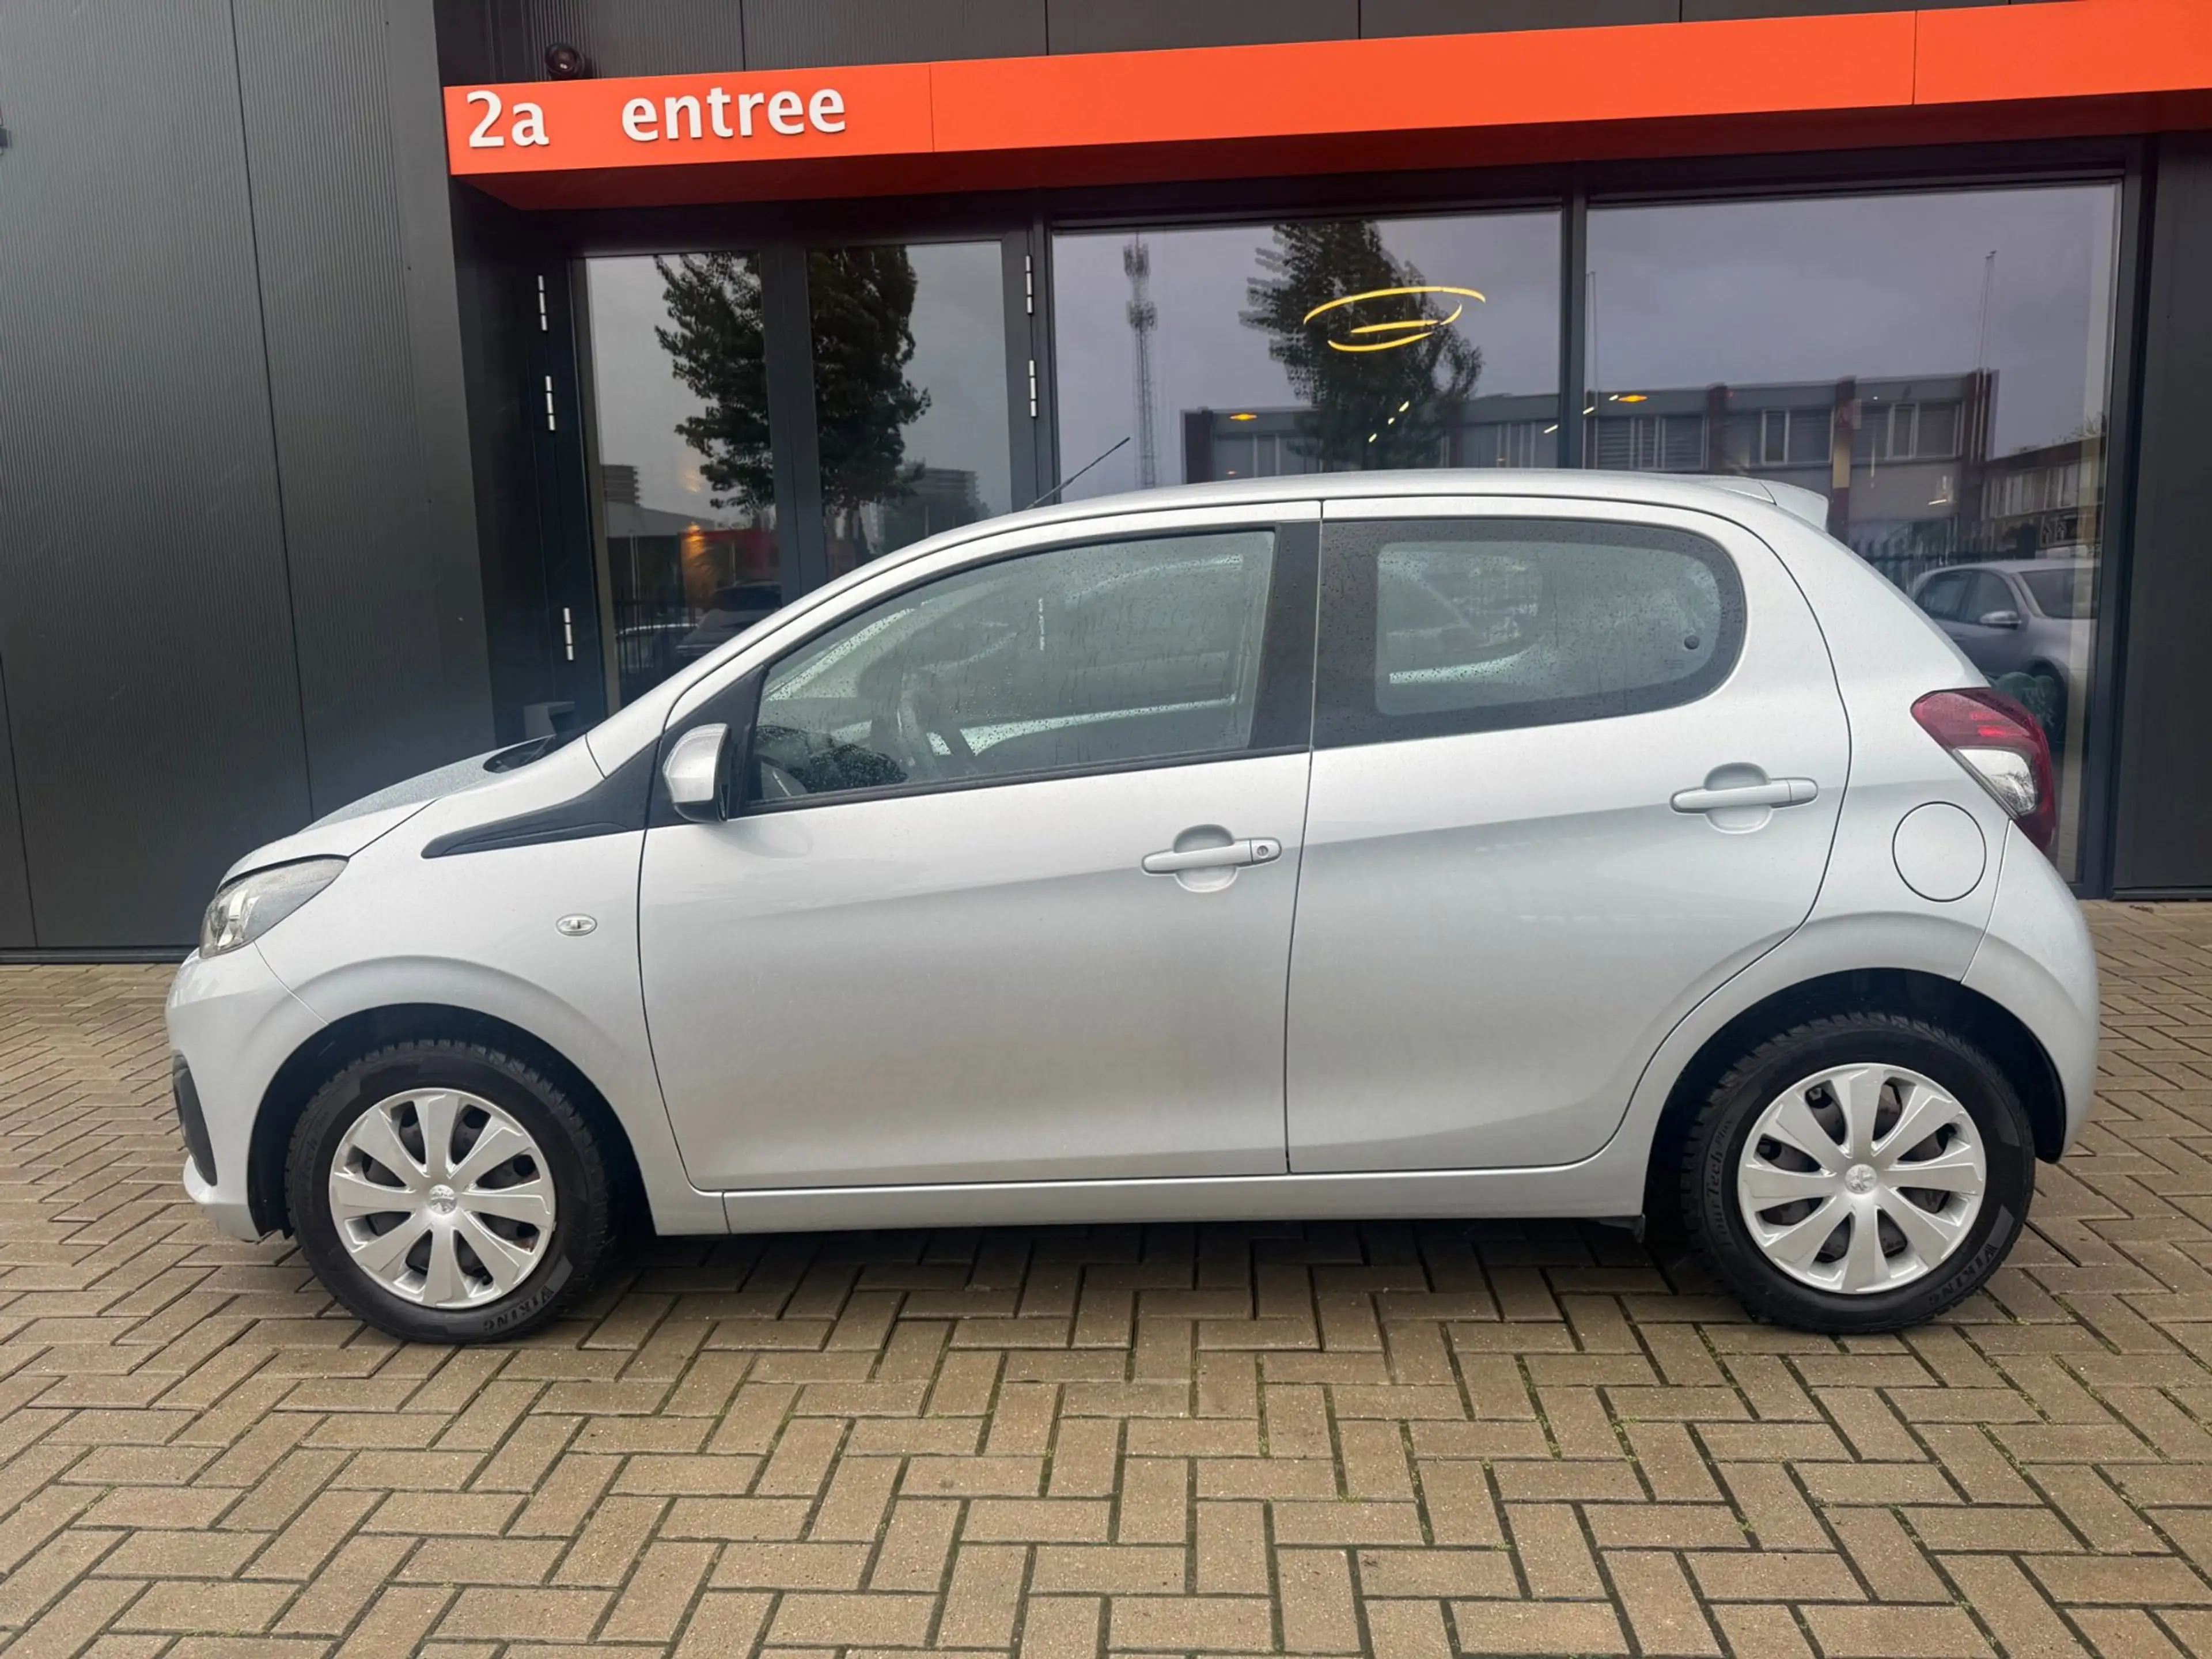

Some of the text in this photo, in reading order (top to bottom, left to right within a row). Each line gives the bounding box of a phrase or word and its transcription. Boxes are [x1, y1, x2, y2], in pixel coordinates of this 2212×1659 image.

[466, 86, 846, 148] 2a entree
[1928, 1243, 1998, 1305] VIKING
[482, 1285, 555, 1332] VIKING
